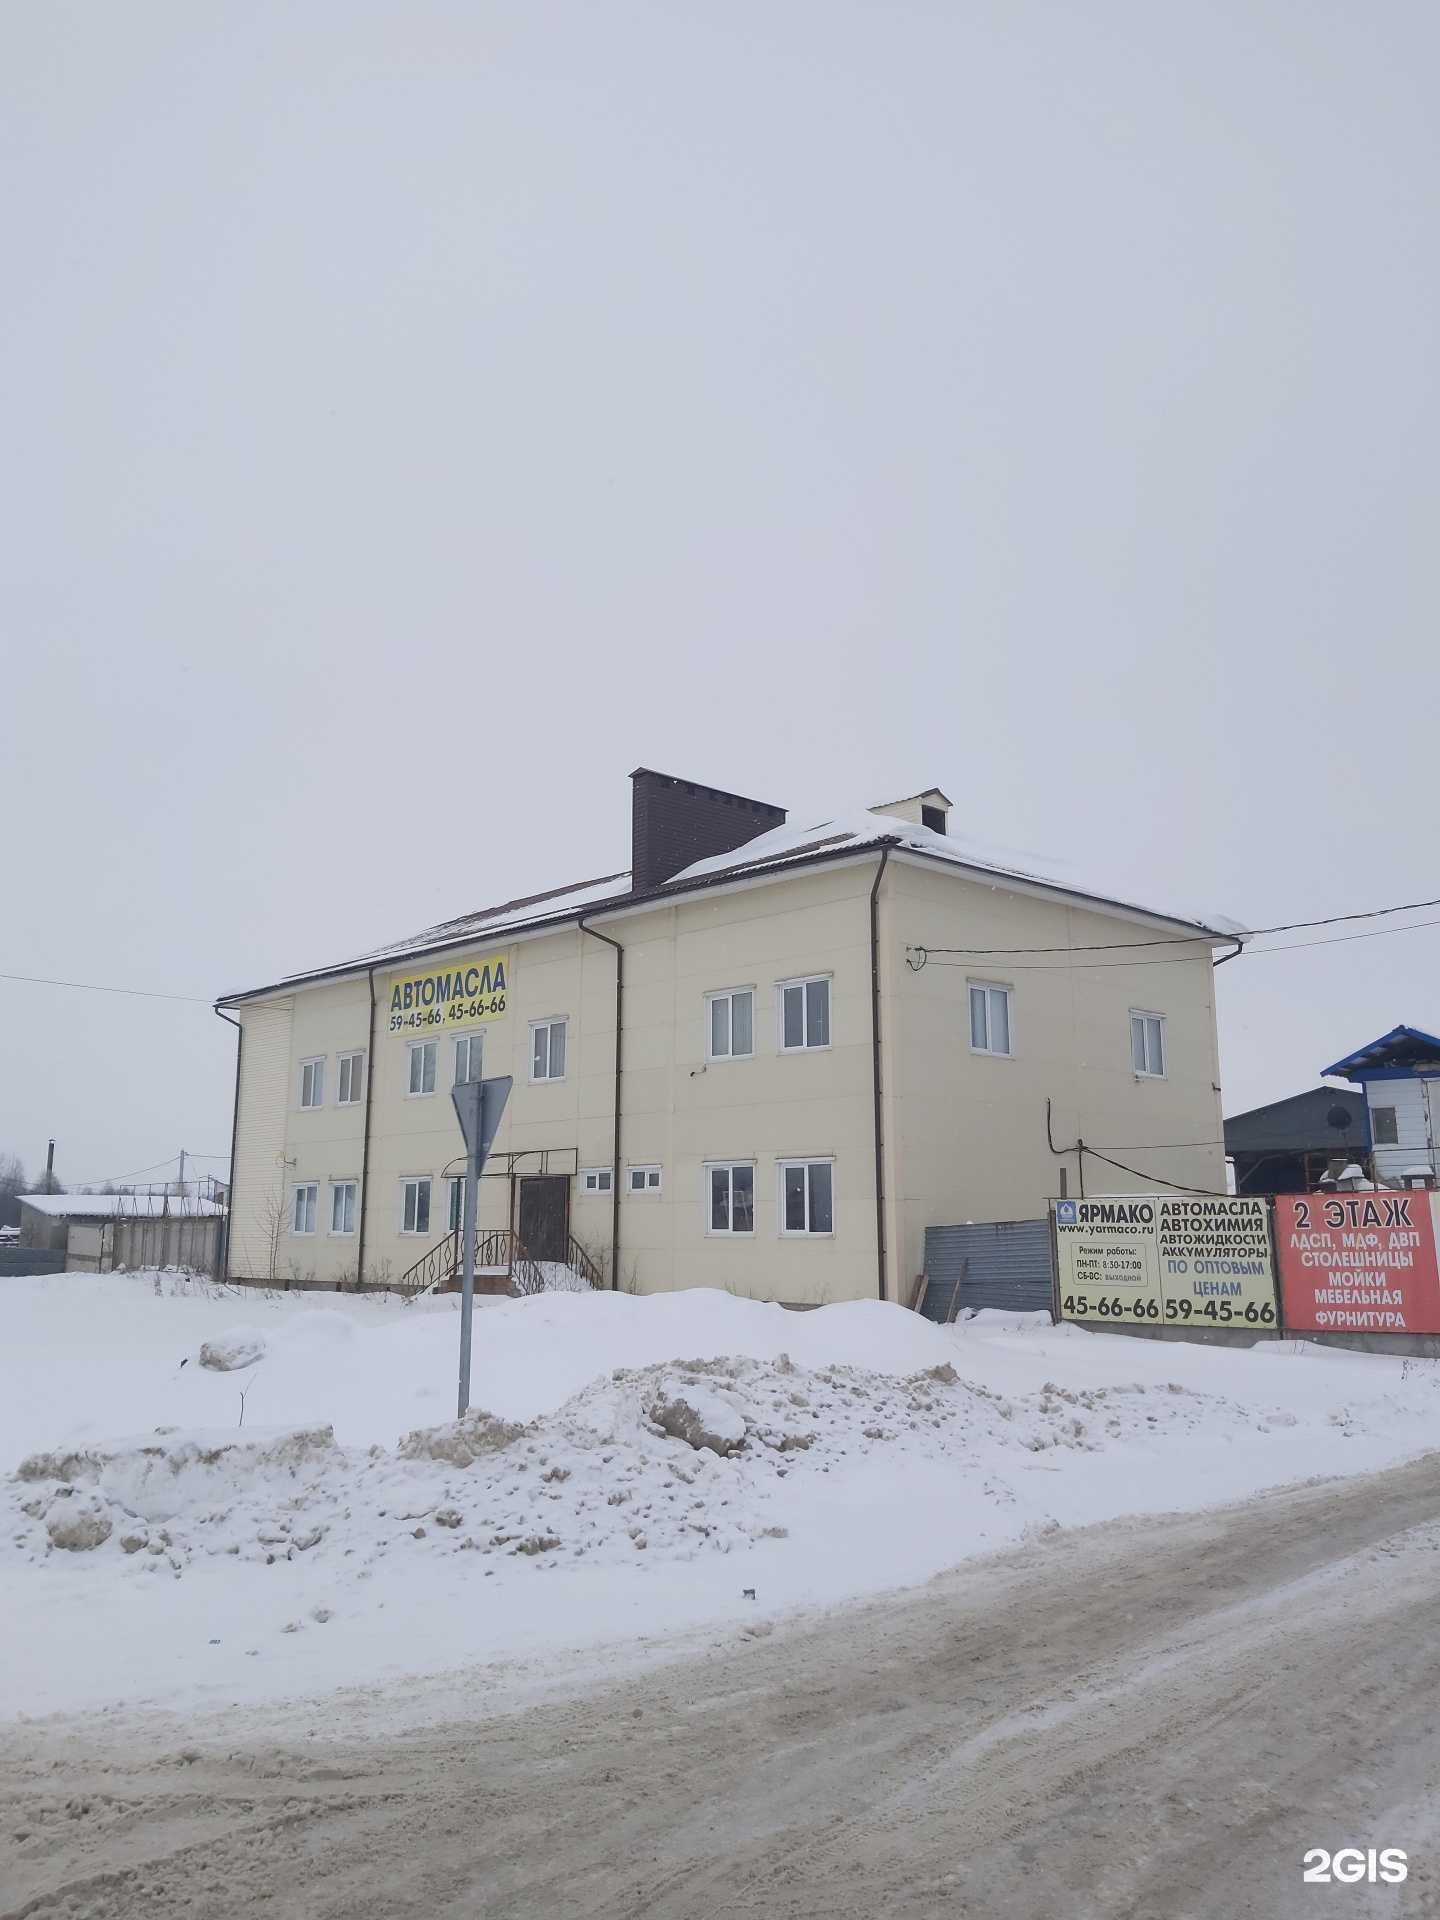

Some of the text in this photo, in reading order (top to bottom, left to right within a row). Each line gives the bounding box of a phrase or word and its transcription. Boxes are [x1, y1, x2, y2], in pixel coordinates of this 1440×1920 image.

[391, 962, 506, 1012] АВТОМАСЛА
[390, 995, 506, 1031] 59-45-66, 45-66-66
[1079, 1203, 1154, 1224] ЯРМАКО
[1160, 1202, 1263, 1216] АВТОМАСЛА
[1293, 1198, 1416, 1229] 2 ЭТАЖ
[1058, 1224, 1154, 1236] www.yarmaco.ru
[1160, 1218, 1264, 1232] АВТОХИМИЯ
[1160, 1234, 1267, 1246] АВТОЖИДКОСТИ
[1290, 1232, 1420, 1250] ЛДСП, МДФ, ДВП
[1079, 1246, 1137, 1257] Режим работы:
[1162, 1247, 1268, 1258] АККУМУЛЯТОРЫ
[1076, 1260, 1142, 1270] ПН-ПТ: 8:30-17:00
[1168, 1260, 1265, 1275] ПО ОПТОВЫМ
[1301, 1251, 1414, 1269] СТОЛЕШНИЦЫ
[1077, 1271, 1102, 1281] СБ-ВС:
[1328, 1269, 1386, 1287] МОЙКИ
[1193, 1281, 1242, 1297] ЦЕНАМ
[1314, 1288, 1403, 1305] МЕБЕЛЬНАЯ
[1063, 1295, 1159, 1318] 45-66-66
[1165, 1299, 1275, 1323] 59-45-66
[1315, 1311, 1406, 1327] ФУРНИТУРА
